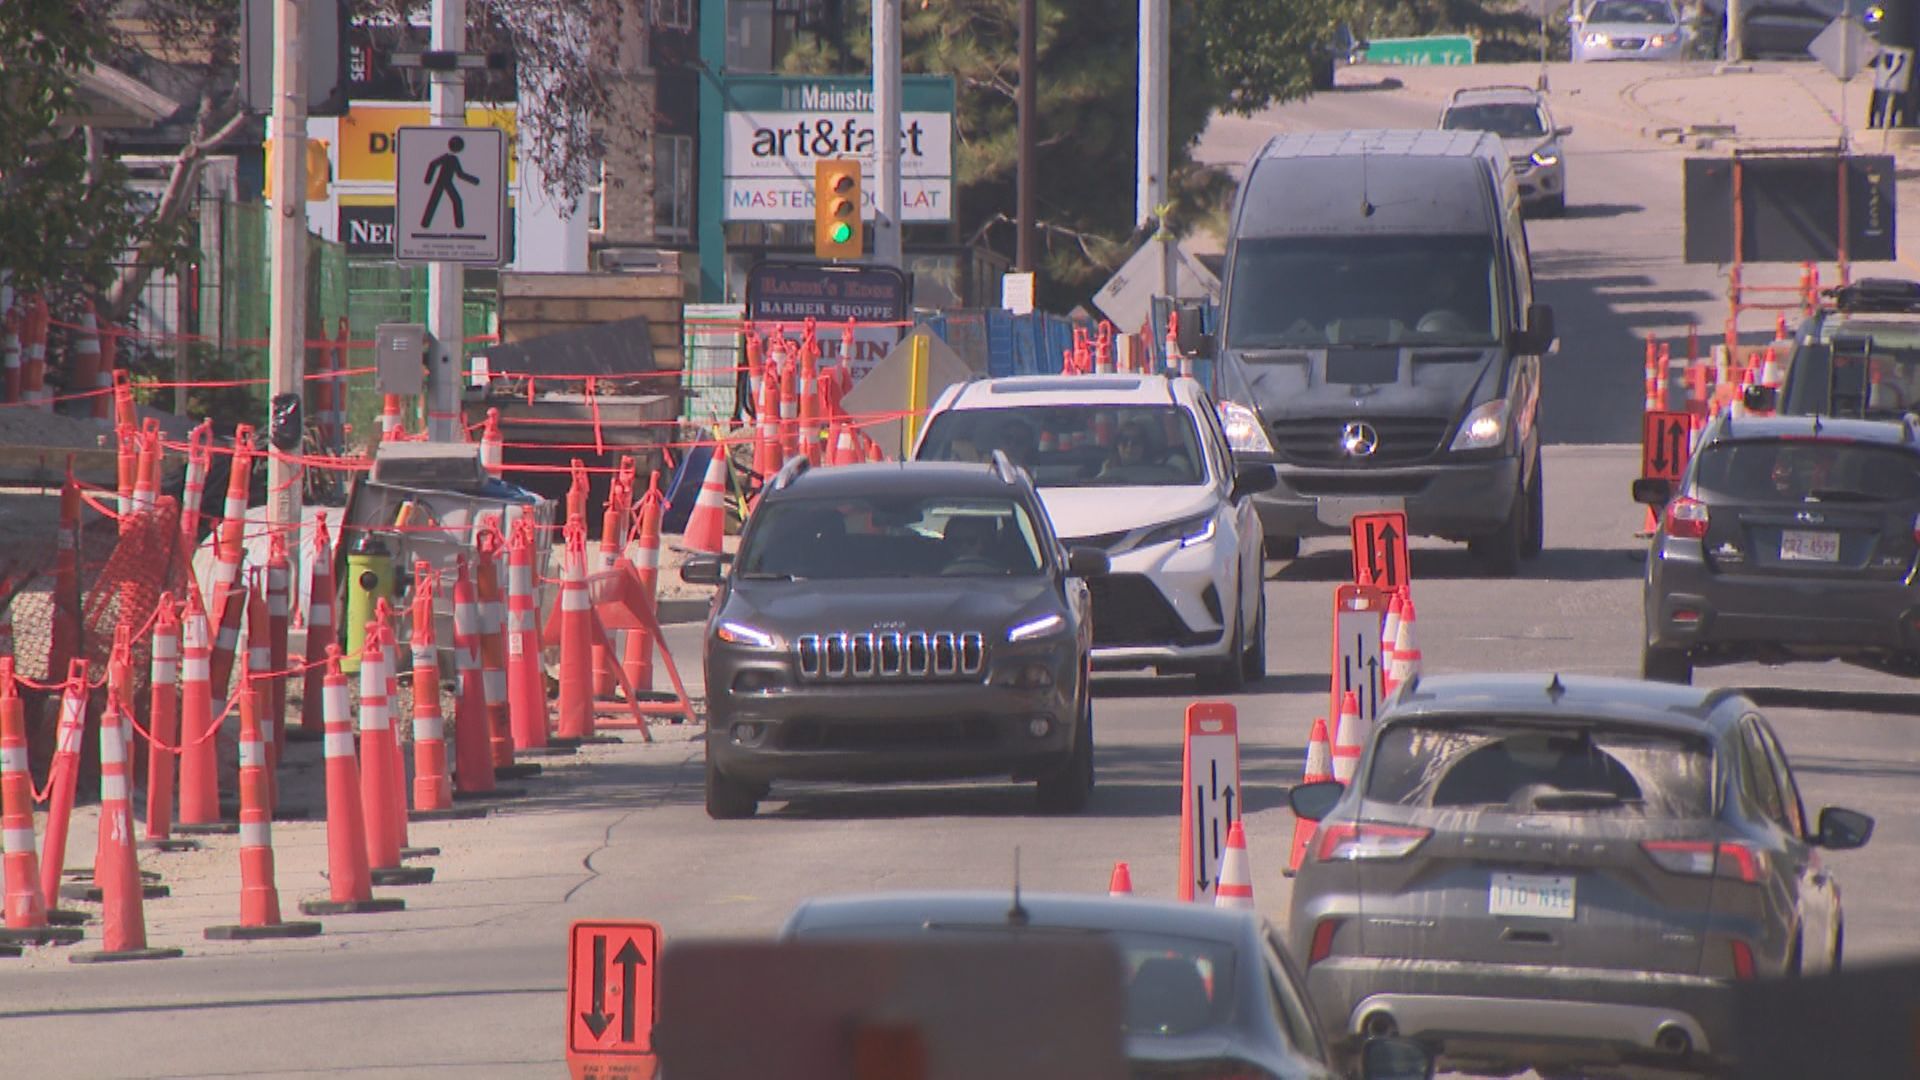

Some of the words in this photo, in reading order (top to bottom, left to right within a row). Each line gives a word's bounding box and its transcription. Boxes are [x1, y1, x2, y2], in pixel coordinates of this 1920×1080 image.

[802, 85, 874, 110] Mainstre
[369, 132, 395, 154] Di
[733, 190, 816, 208] MASTER
[350, 220, 394, 244] NEI
[761, 301, 826, 315] BARBER
[831, 305, 893, 318] SHOPPE
